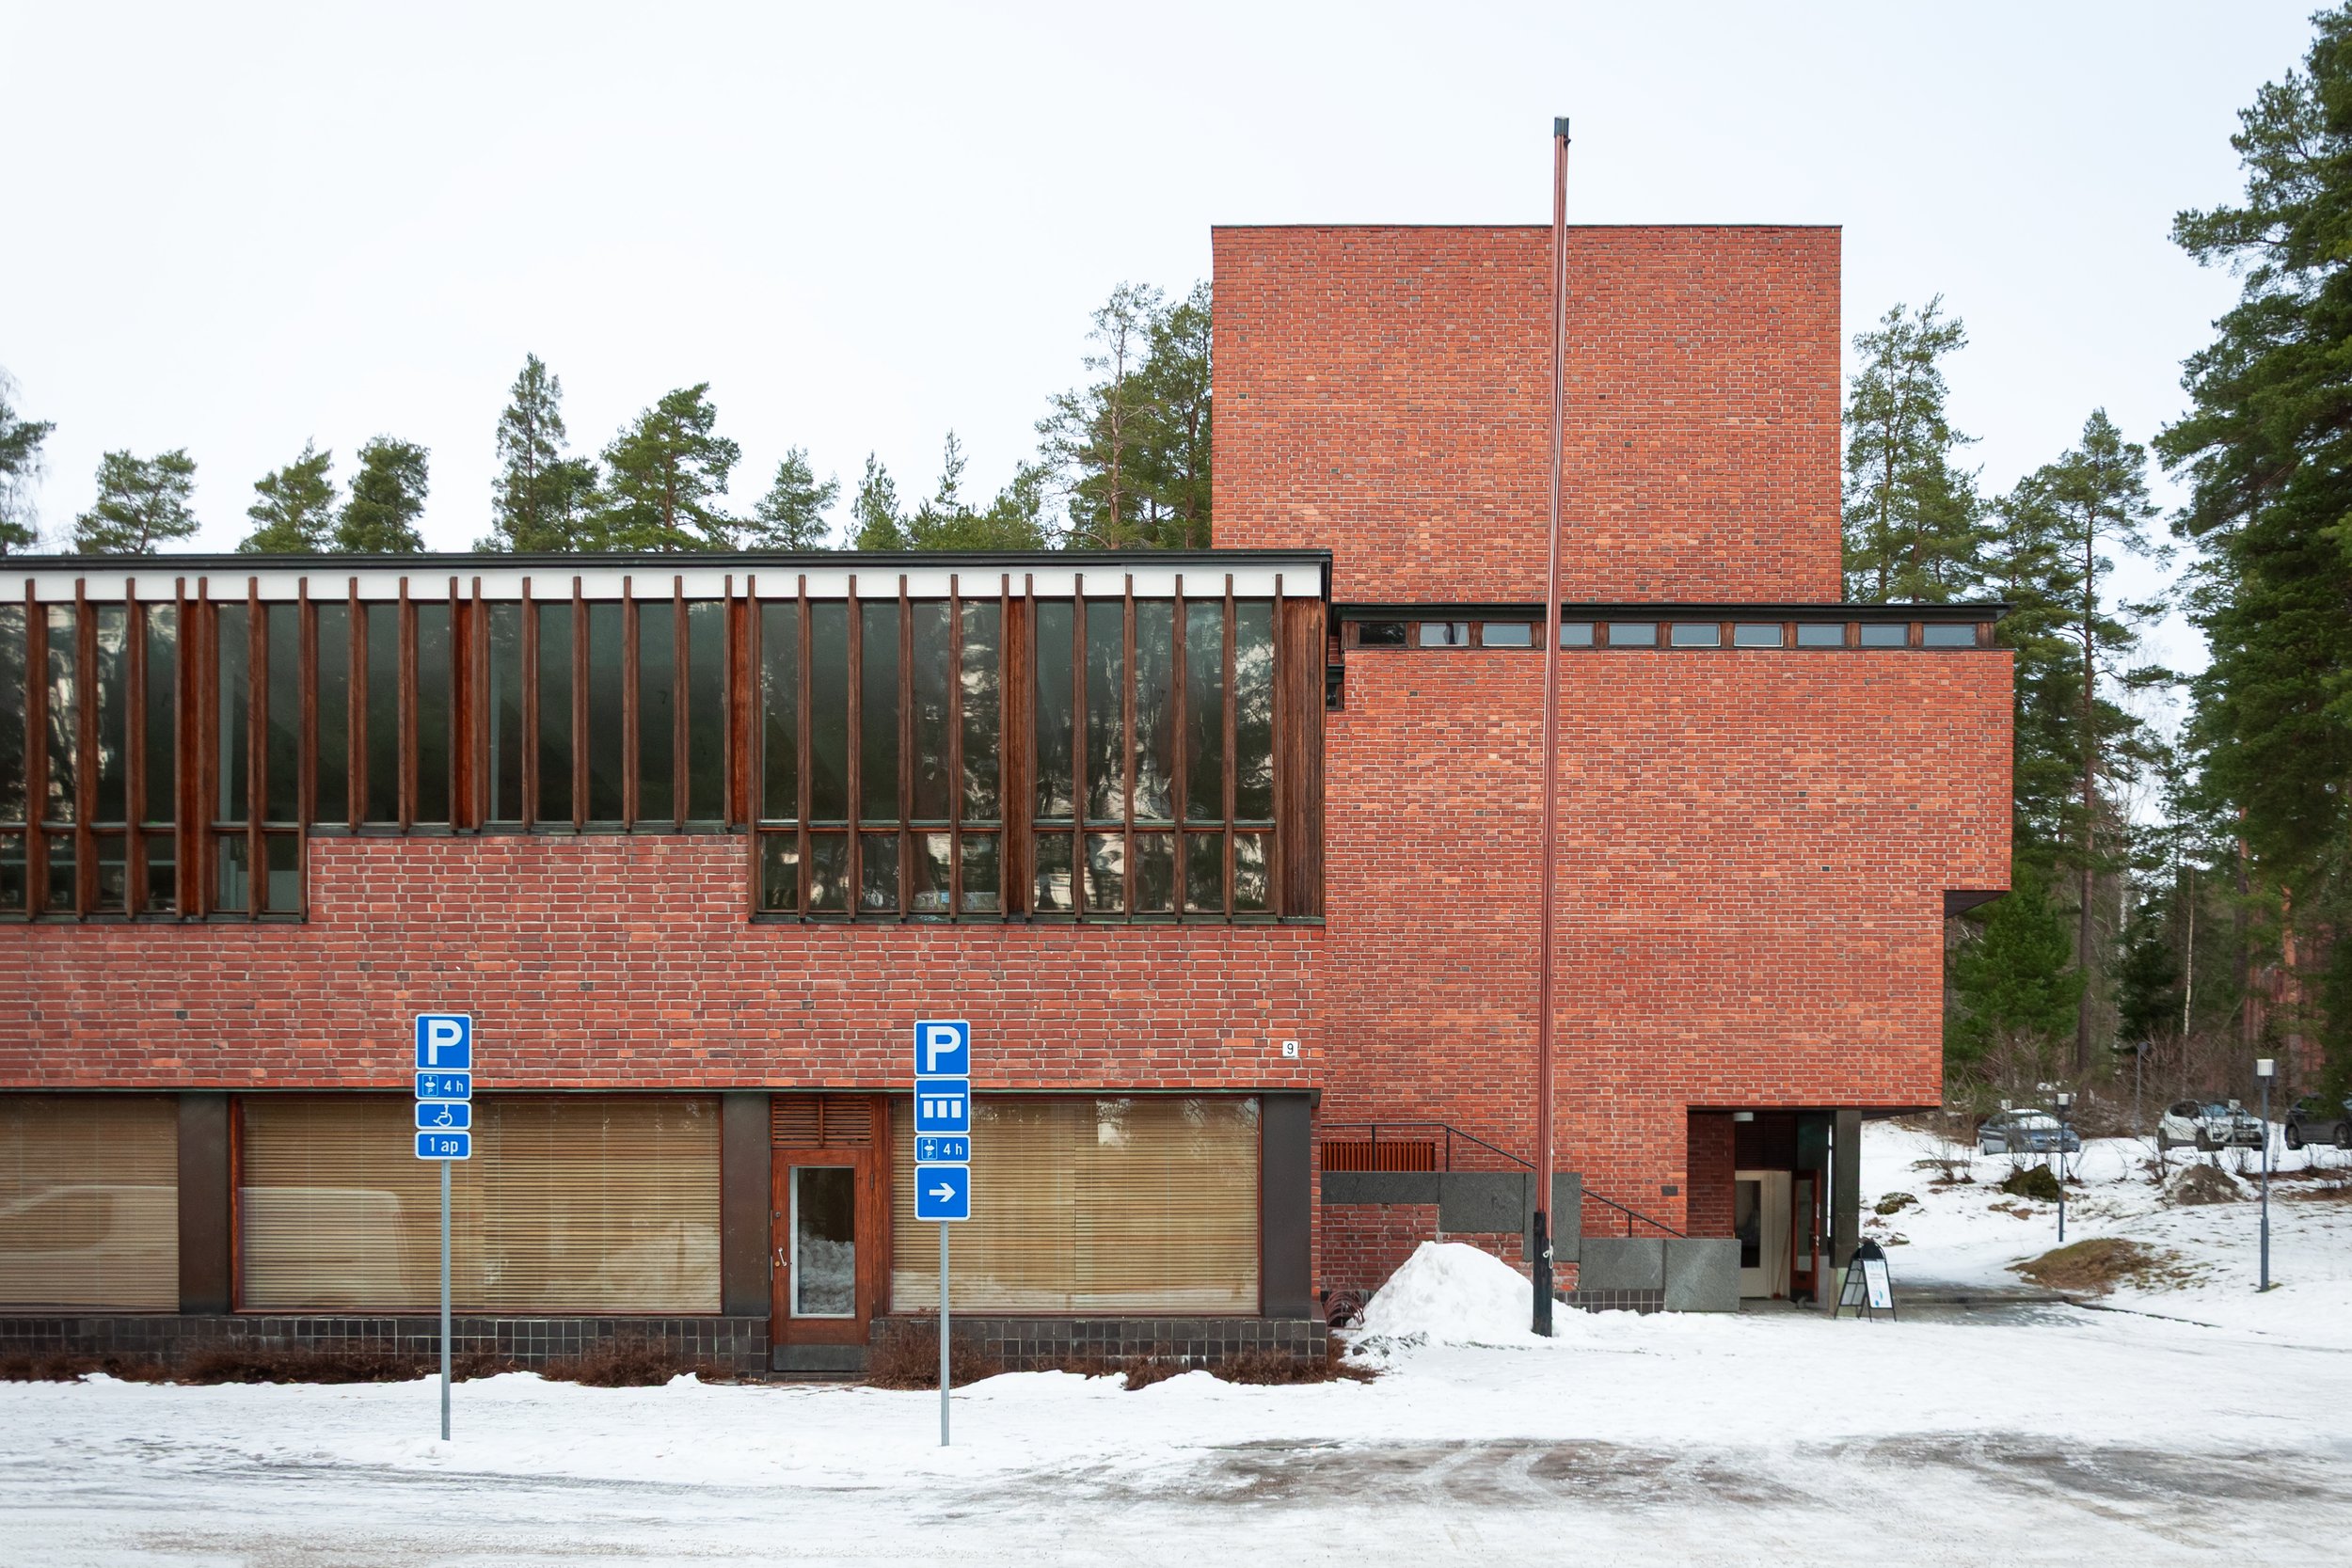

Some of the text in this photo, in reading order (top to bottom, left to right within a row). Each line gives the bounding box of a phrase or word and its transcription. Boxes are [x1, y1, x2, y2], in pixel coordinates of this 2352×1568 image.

[428, 1020, 463, 1065] P
[927, 1025, 961, 1071] P
[1287, 1042, 1294, 1054] 9
[444, 1080, 464, 1092] 4 h
[429, 1137, 458, 1154] 1 ap
[943, 1144, 962, 1155] 4 h
